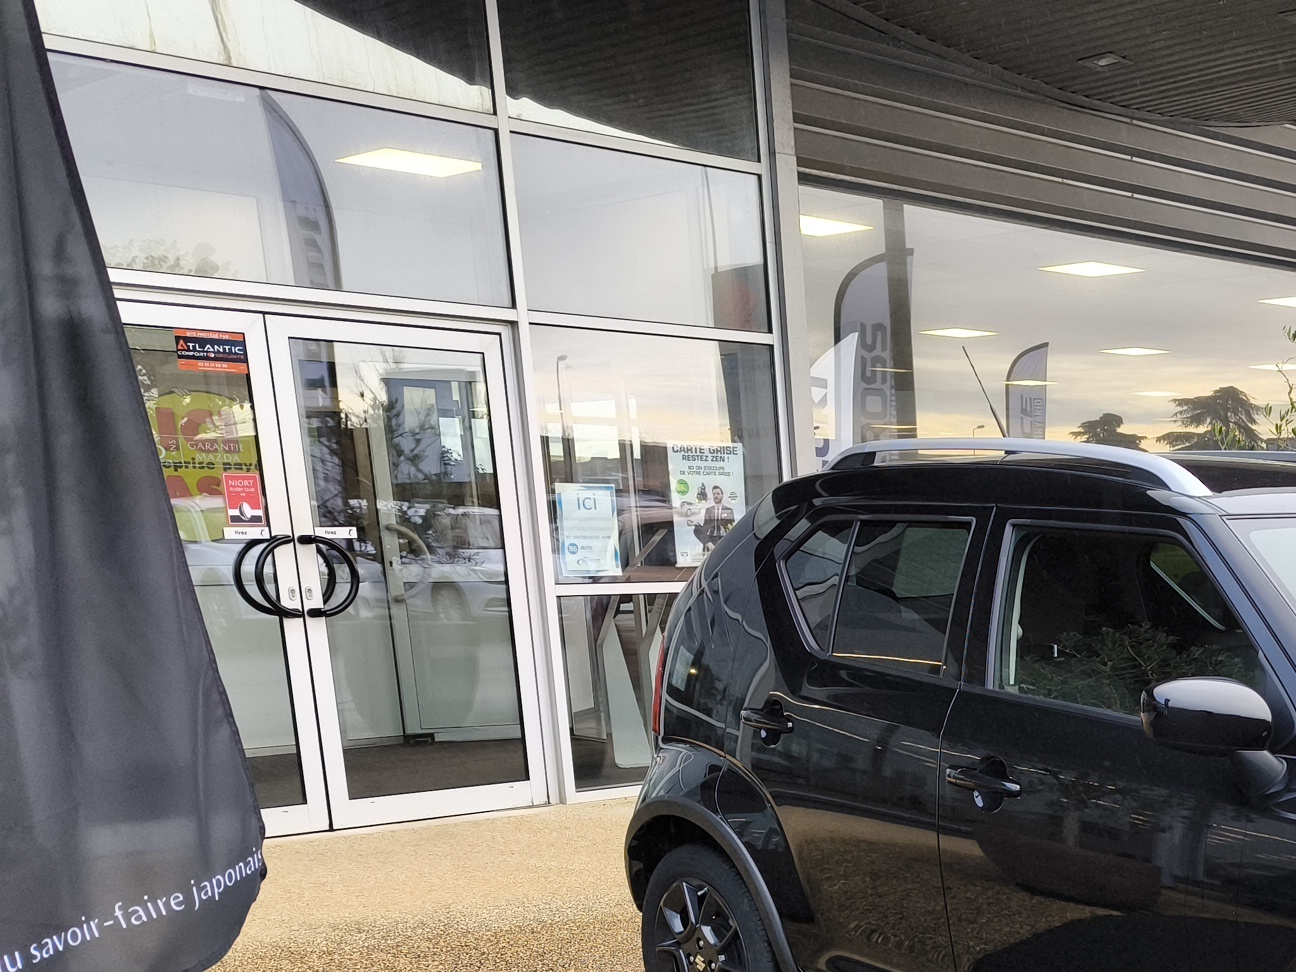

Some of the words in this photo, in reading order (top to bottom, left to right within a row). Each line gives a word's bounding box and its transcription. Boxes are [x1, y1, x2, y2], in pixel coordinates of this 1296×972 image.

[178, 339, 244, 354] ATLANTIC
[1032, 397, 1044, 437] HYBRID
[672, 444, 705, 454] CARTE
[708, 445, 738, 455] GRISE
[195, 453, 241, 462] MAZDA
[682, 454, 709, 462] RESTEZ
[228, 480, 253, 488] NIORT
[576, 492, 597, 510] ici
[30, 896, 185, 964] savoir-faire
